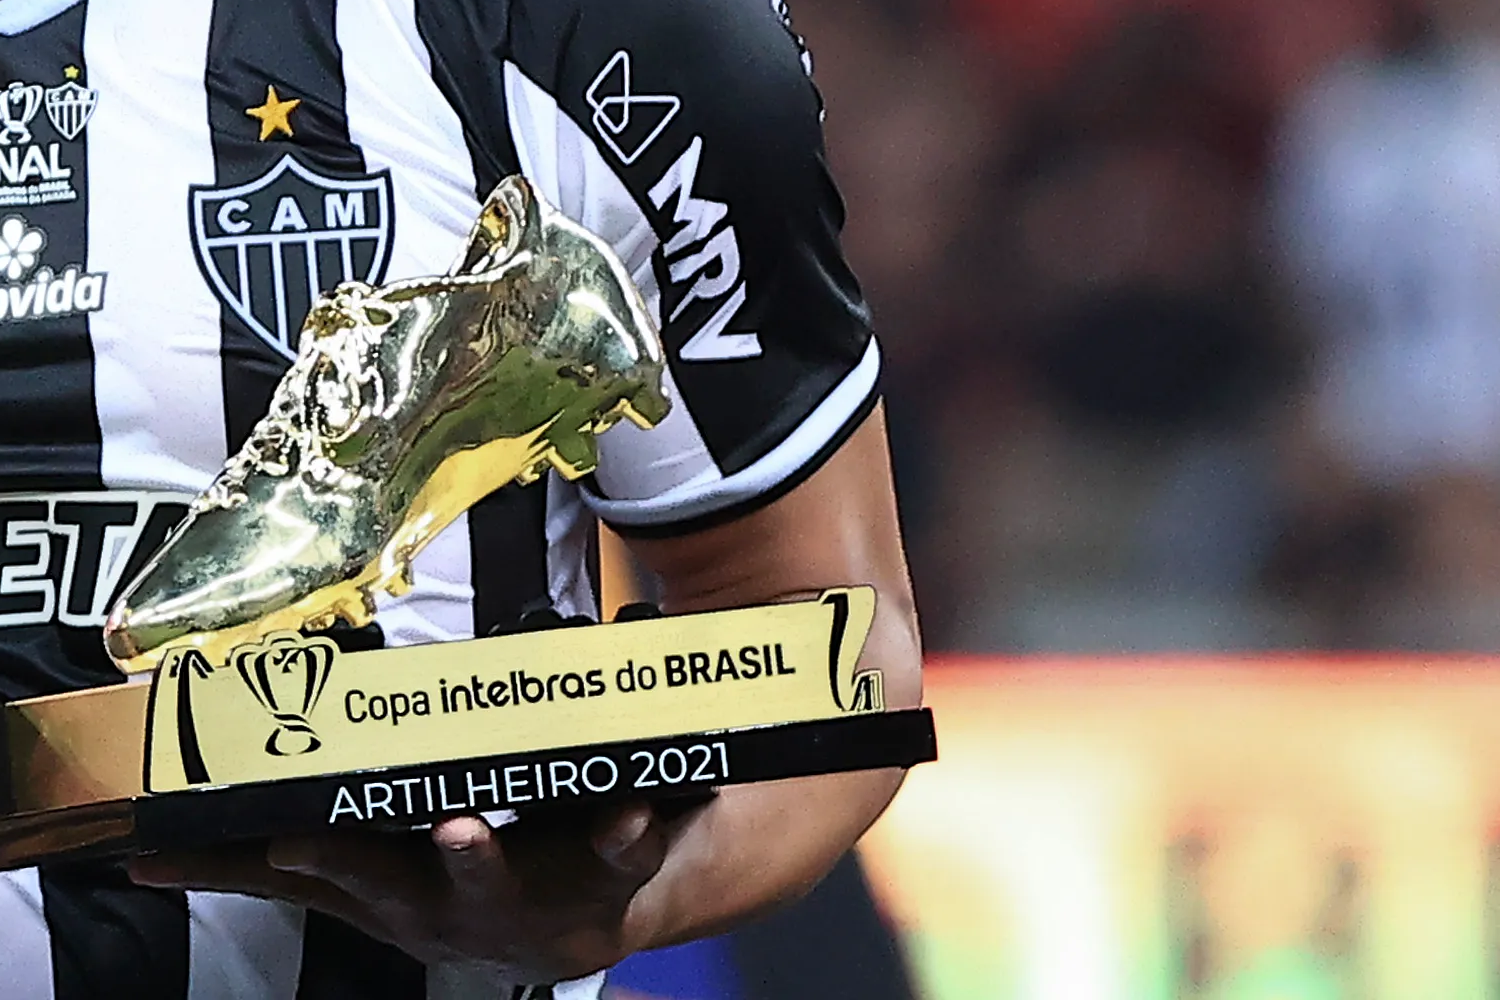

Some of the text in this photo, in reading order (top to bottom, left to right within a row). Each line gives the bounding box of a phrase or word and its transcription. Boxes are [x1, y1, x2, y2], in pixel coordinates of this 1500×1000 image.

[217, 192, 366, 233] CAM
[647, 136, 762, 360] MRV
[344, 643, 796, 726] Copa intelbras do BRASIL
[328, 741, 731, 825] ARTILHEIRO 2021
